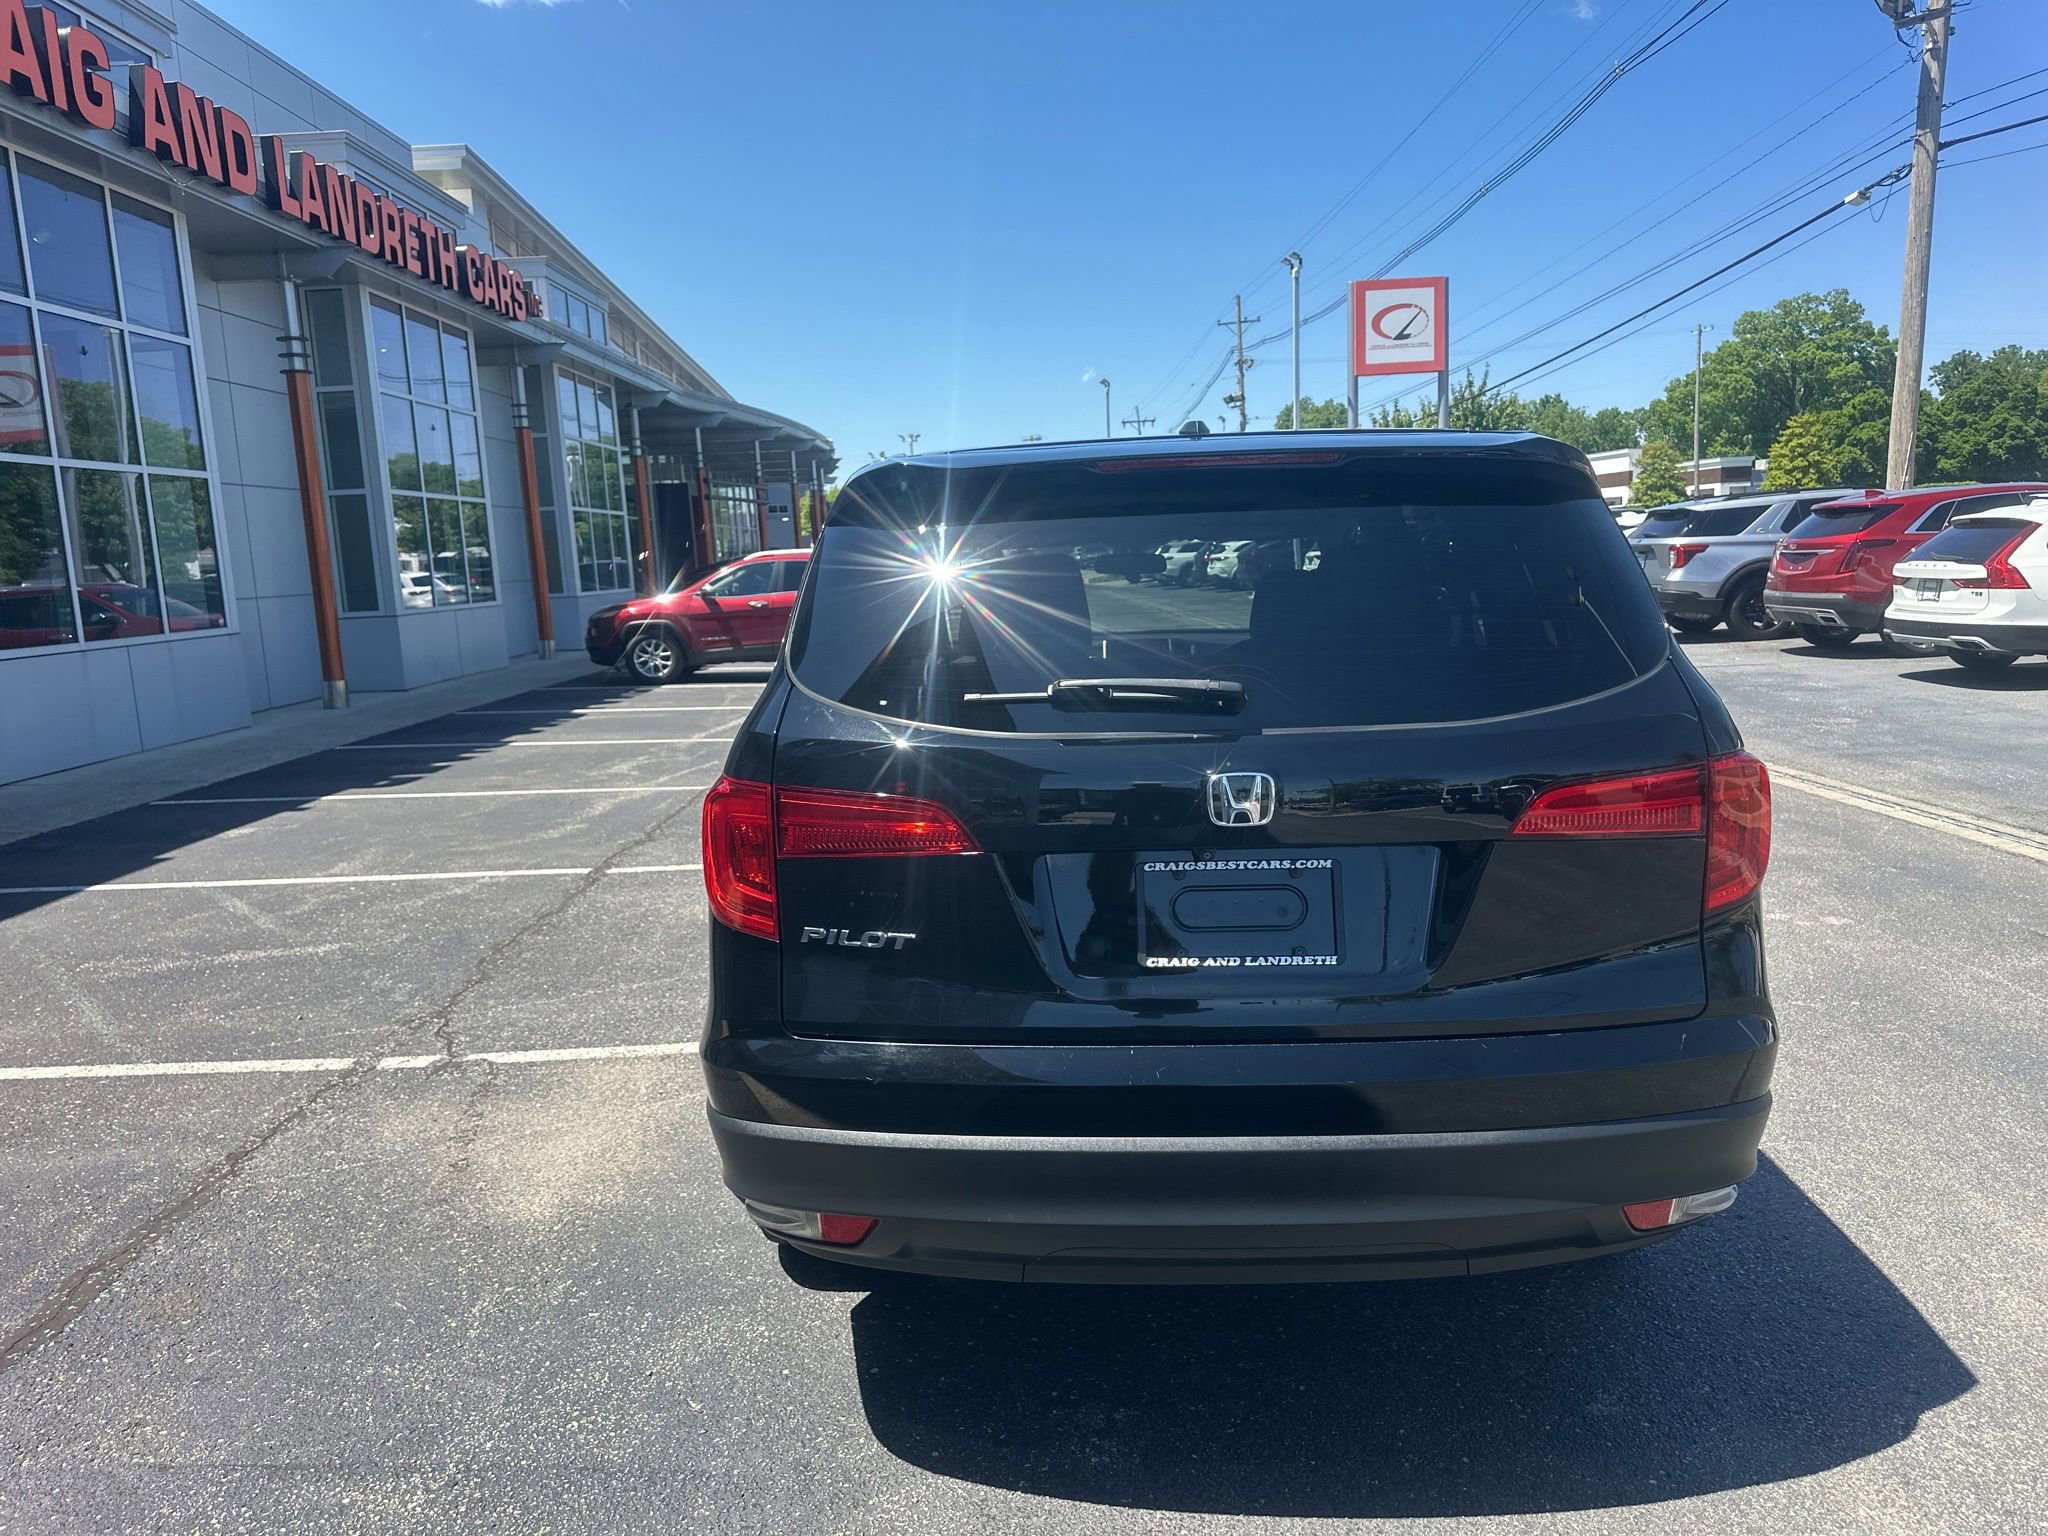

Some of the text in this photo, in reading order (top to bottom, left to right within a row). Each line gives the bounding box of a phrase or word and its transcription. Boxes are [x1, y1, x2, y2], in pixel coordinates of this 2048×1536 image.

[144, 64, 258, 196] AND
[273, 135, 459, 291] LANDRETH
[466, 243, 528, 321] CARS
[1143, 859, 1333, 872] CRAIGSBESTCARS.COM
[800, 926, 916, 950] PILOT
[1146, 955, 1338, 967] CRAIG AND LANDRETH
